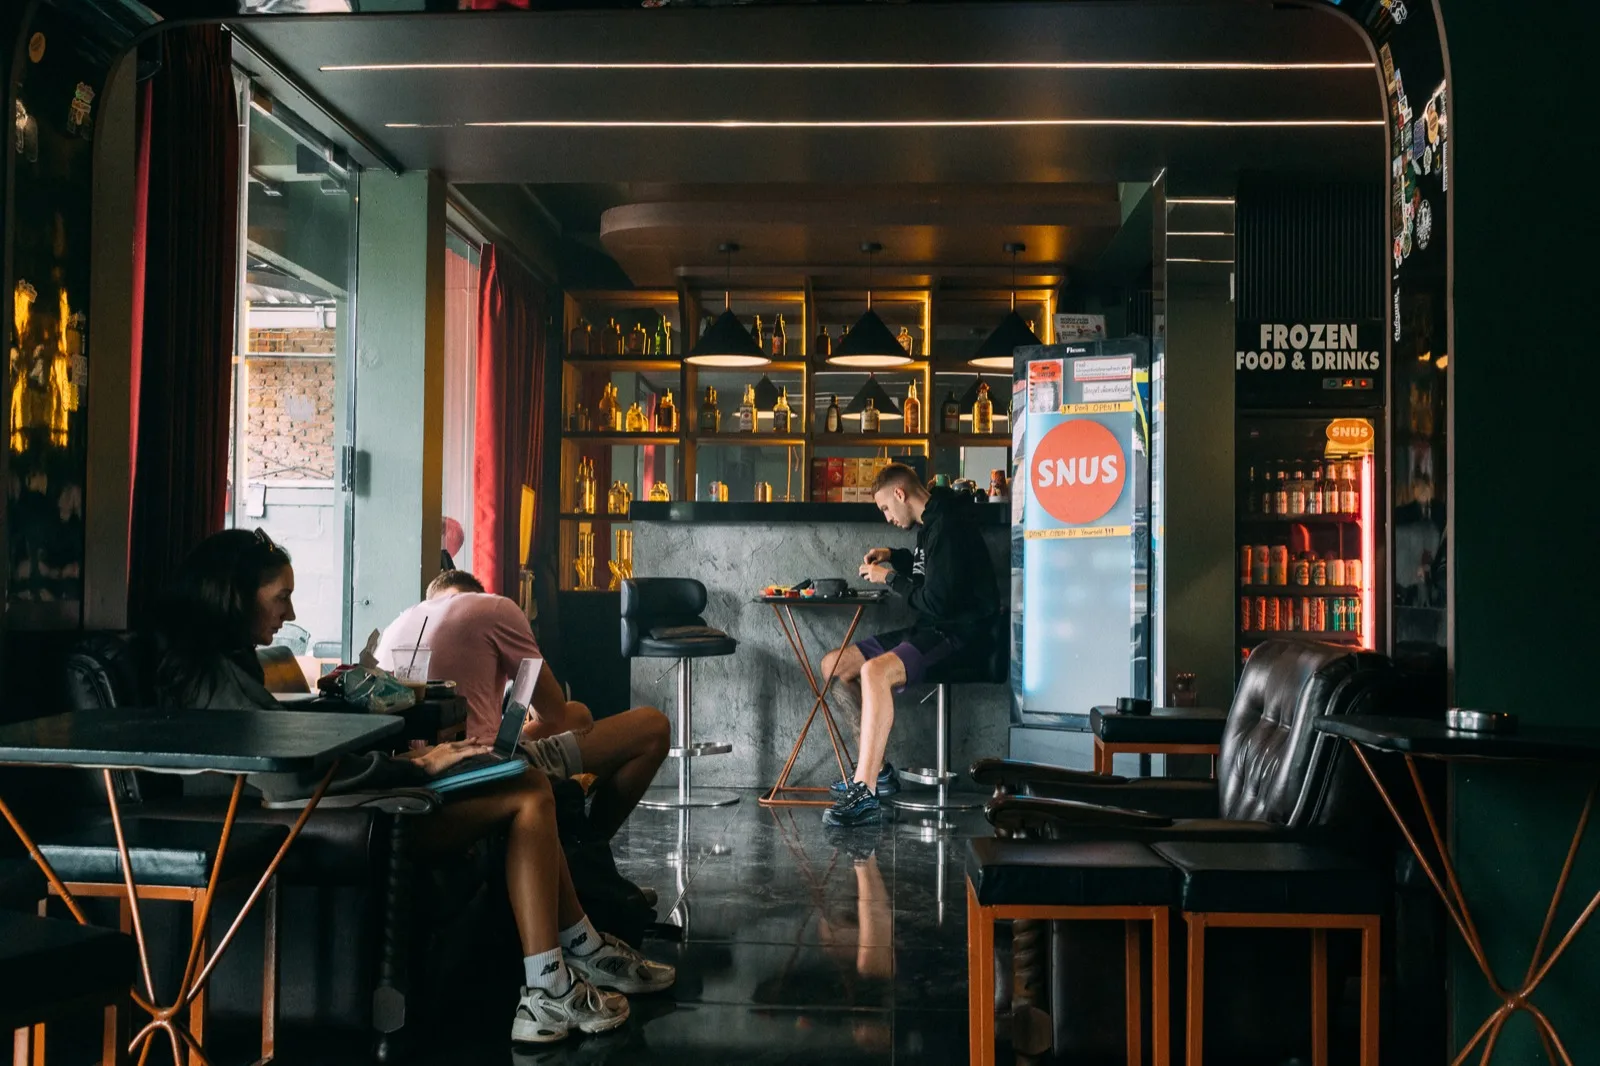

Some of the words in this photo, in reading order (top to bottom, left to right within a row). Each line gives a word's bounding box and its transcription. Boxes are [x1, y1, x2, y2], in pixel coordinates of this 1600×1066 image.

[1260, 324, 1358, 350] FROZEN
[1236, 351, 1286, 371] FOOD
[1291, 351, 1306, 371] &
[1311, 351, 1380, 371] DRINKS
[1092, 403, 1112, 411] OPEN
[1331, 426, 1369, 438] SNUS
[1038, 454, 1118, 488] SNUS
[1050, 529, 1066, 537] OPEN
